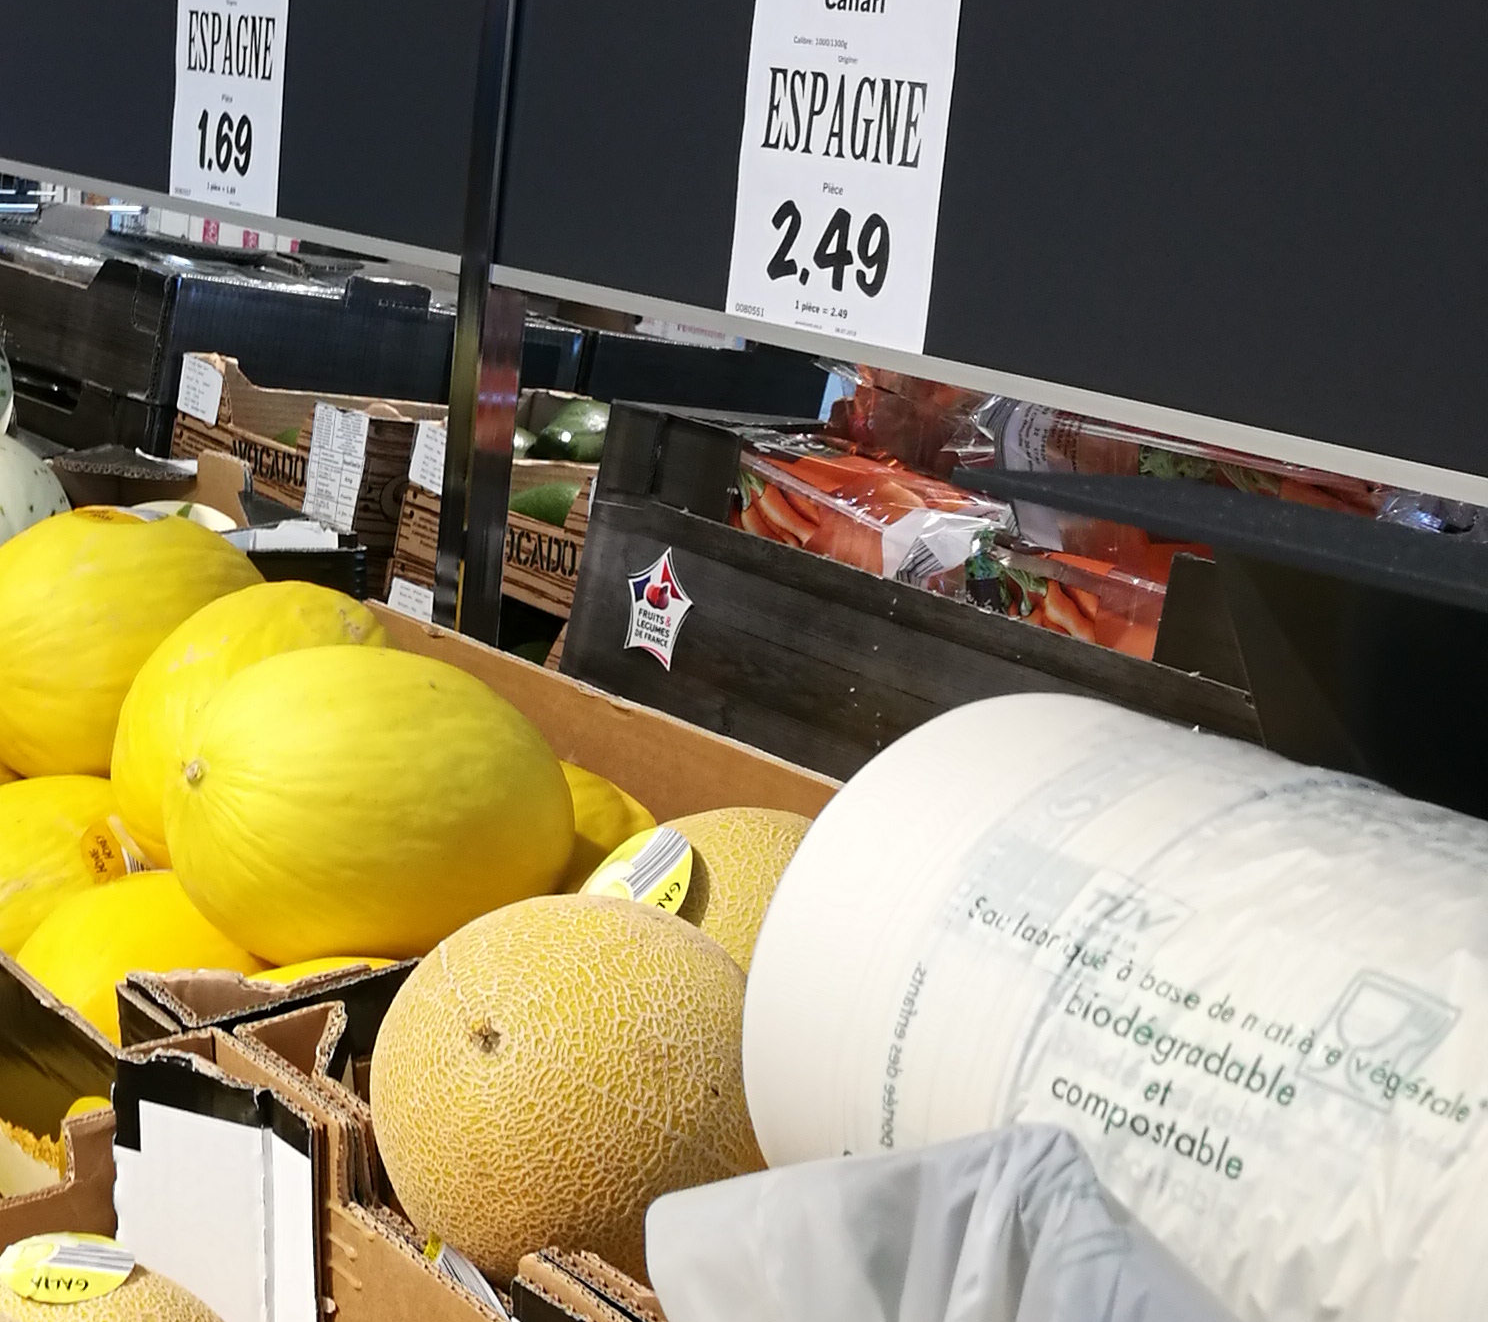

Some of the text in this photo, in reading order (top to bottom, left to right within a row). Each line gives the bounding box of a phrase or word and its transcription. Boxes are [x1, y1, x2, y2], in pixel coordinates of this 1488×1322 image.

[187, 9, 276, 82] ESPAGNE
[761, 66, 929, 169] ESPAGNE
[197, 109, 253, 177] 1.69
[822, 182, 844, 196] Pièce
[766, 199, 891, 299] 2.49
[801, 301, 820, 316] pièce
[830, 307, 848, 319] 2.49
[634, 628, 668, 649] DE FRANCE
[638, 608, 672, 628] FRUITS &
[656, 882, 681, 909] GAL
[1064, 980, 1297, 1107] biodégradable
[1139, 966, 1201, 1011] base
[1208, 992, 1235, 1024] de
[1354, 1055, 1472, 1124] végétale
[1143, 1079, 1173, 1107] et
[1050, 1076, 1244, 1180] compostable
[31, 1275, 89, 1291] GALIA
